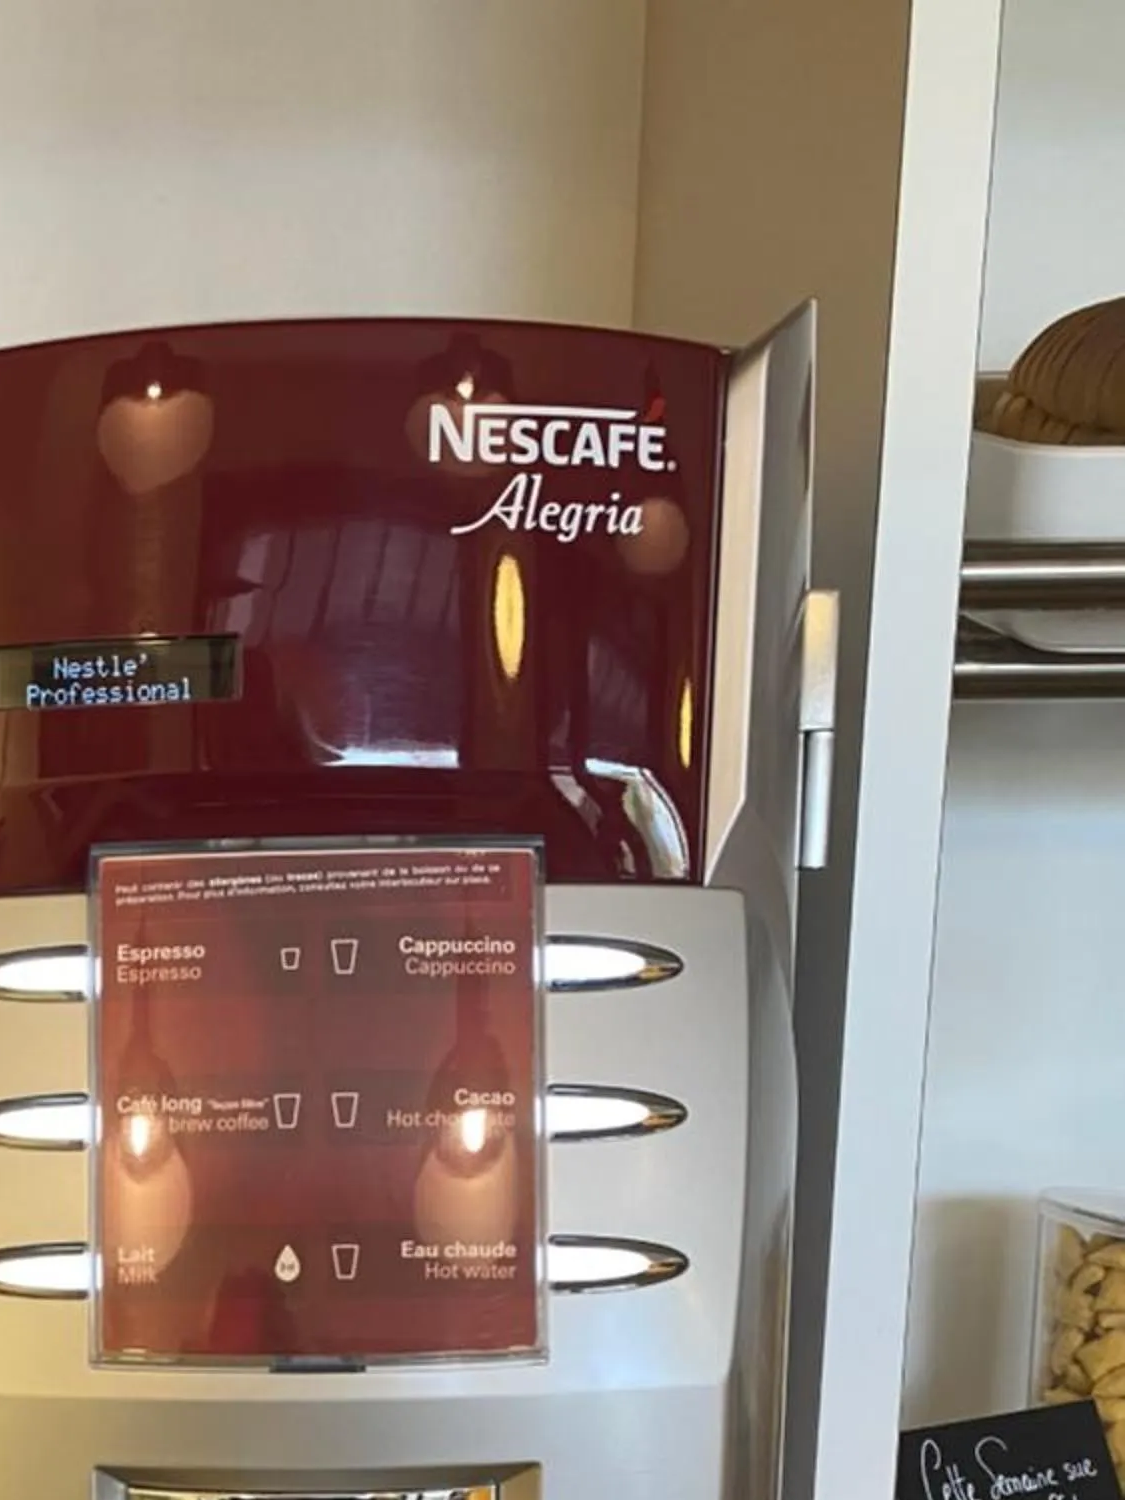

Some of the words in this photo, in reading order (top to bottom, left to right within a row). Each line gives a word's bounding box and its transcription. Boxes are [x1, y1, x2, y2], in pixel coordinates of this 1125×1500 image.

[450, 472, 644, 544] Alegria
[25, 677, 191, 711] Professional
[116, 943, 206, 964] Espresso
[398, 936, 516, 956] Cappuccino
[116, 963, 203, 985] Espresso
[405, 957, 516, 977] Cappuccino
[116, 1094, 157, 1114] Café
[161, 1094, 202, 1115] long
[453, 1088, 516, 1106] Cacao
[168, 1116, 212, 1133] brew
[215, 1112, 269, 1132] coffee
[386, 1109, 422, 1128] Hot
[400, 1241, 439, 1259] Eau
[443, 1241, 517, 1259] chaude
[424, 1262, 459, 1280] Hot
[462, 1264, 517, 1280] water
